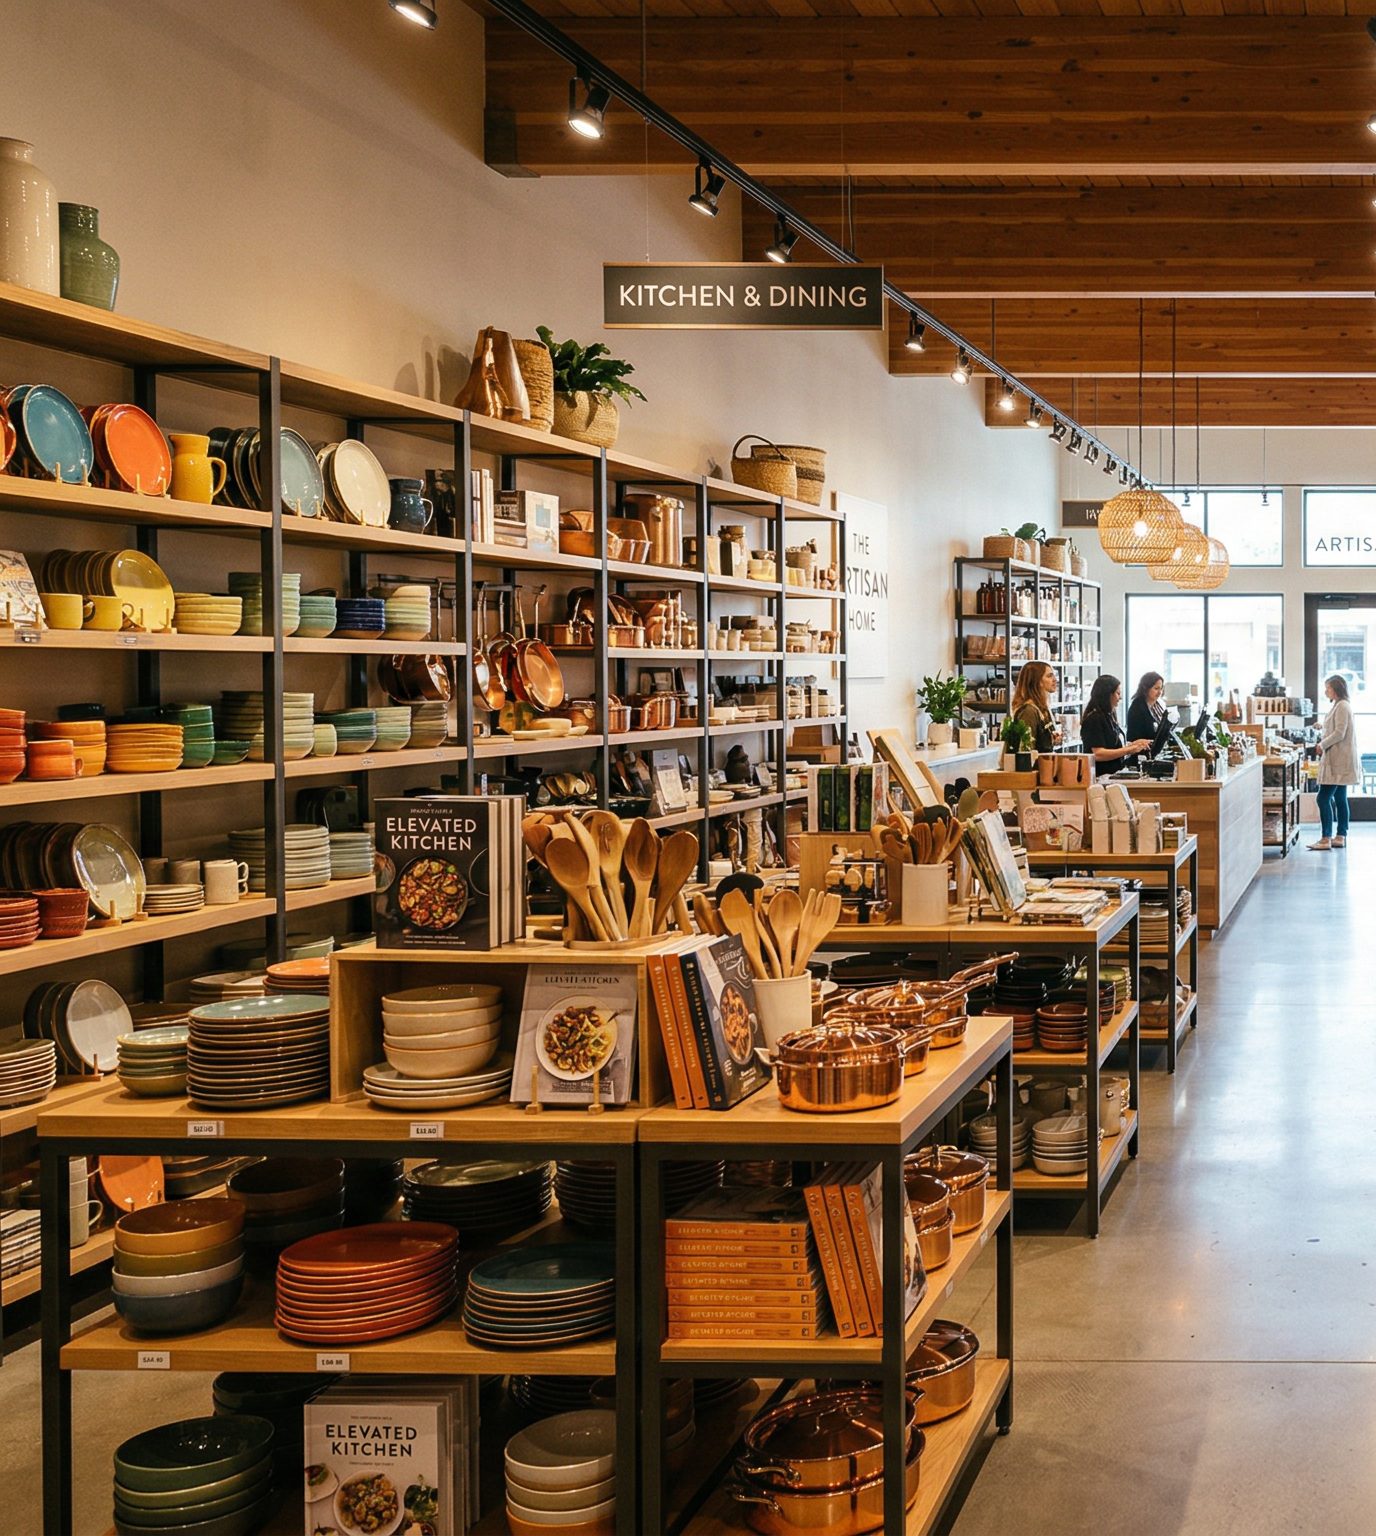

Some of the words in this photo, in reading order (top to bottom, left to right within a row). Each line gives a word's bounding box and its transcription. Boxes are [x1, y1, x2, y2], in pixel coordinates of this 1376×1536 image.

[619, 284, 734, 307] KITCHEN
[743, 285, 761, 307] &
[769, 286, 867, 308] DINING
[852, 532, 870, 555] THE
[848, 609, 876, 631] HOME
[386, 817, 477, 833] ELEVATED
[391, 835, 472, 851] KITCHEN
[325, 1424, 417, 1440] ELEVATED
[331, 1442, 412, 1457] KITCHEN
